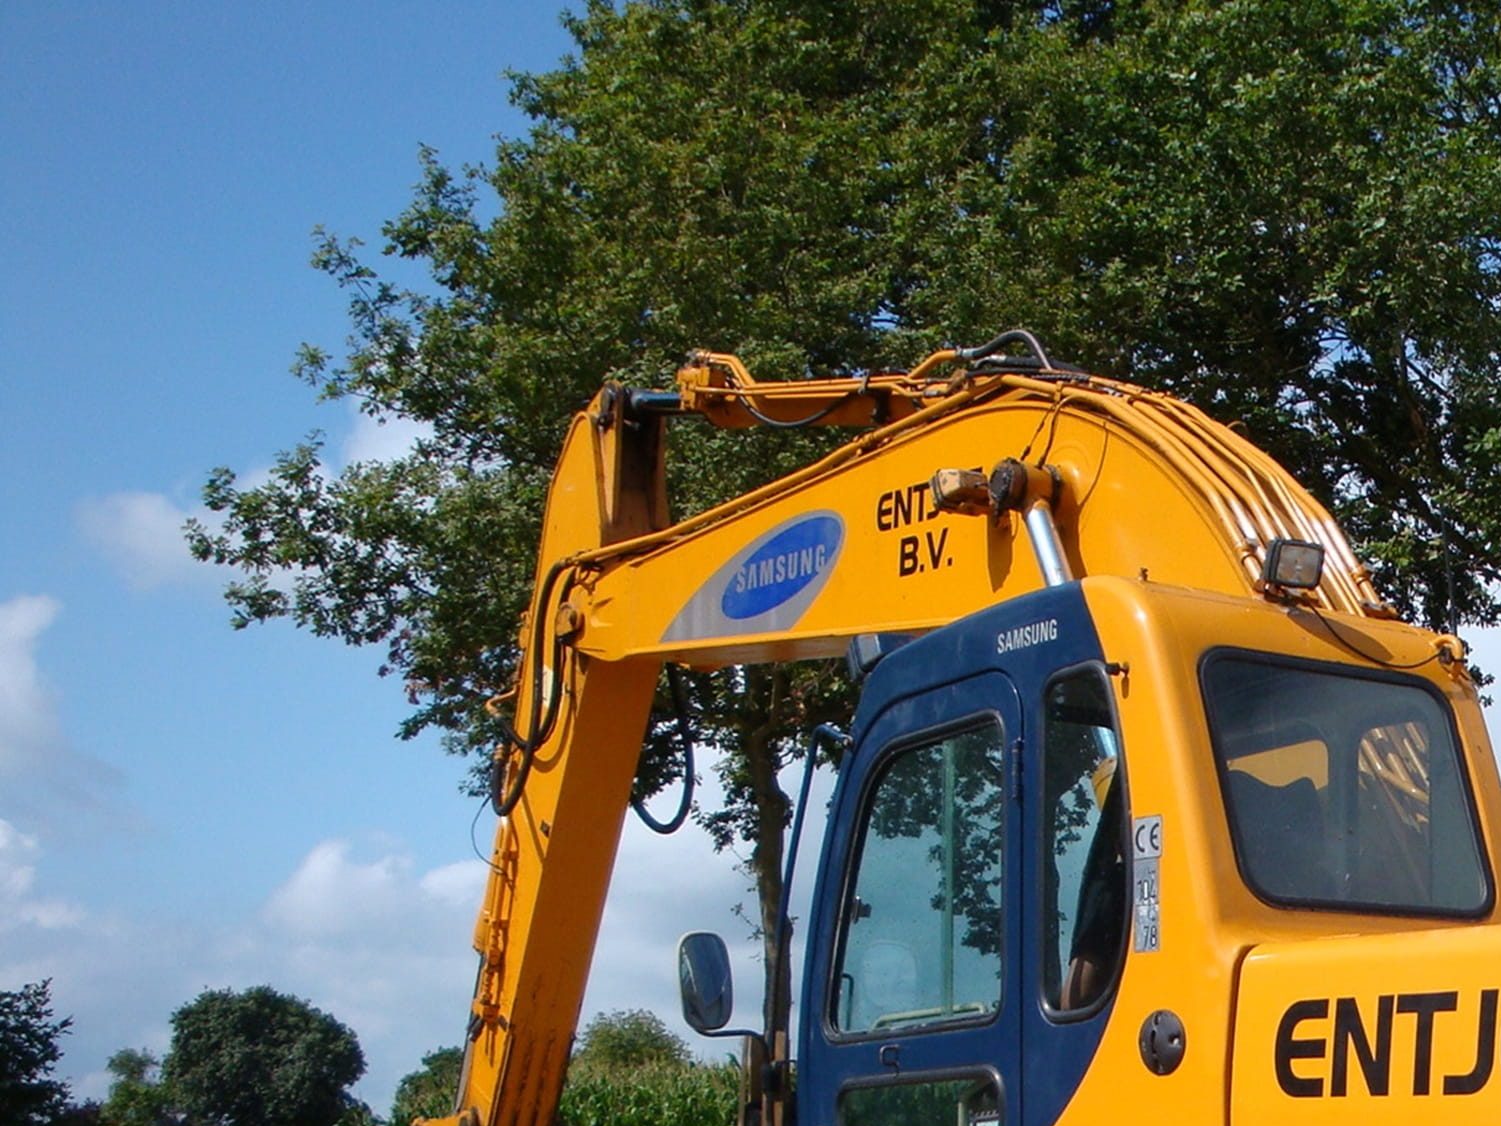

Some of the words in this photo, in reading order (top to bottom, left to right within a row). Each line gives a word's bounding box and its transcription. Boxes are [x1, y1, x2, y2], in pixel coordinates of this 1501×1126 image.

[736, 543, 826, 593] SAMSUNG
[899, 527, 953, 577] B.V.
[996, 618, 1058, 654] SAMSUNG
[1135, 822, 1160, 853] CE
